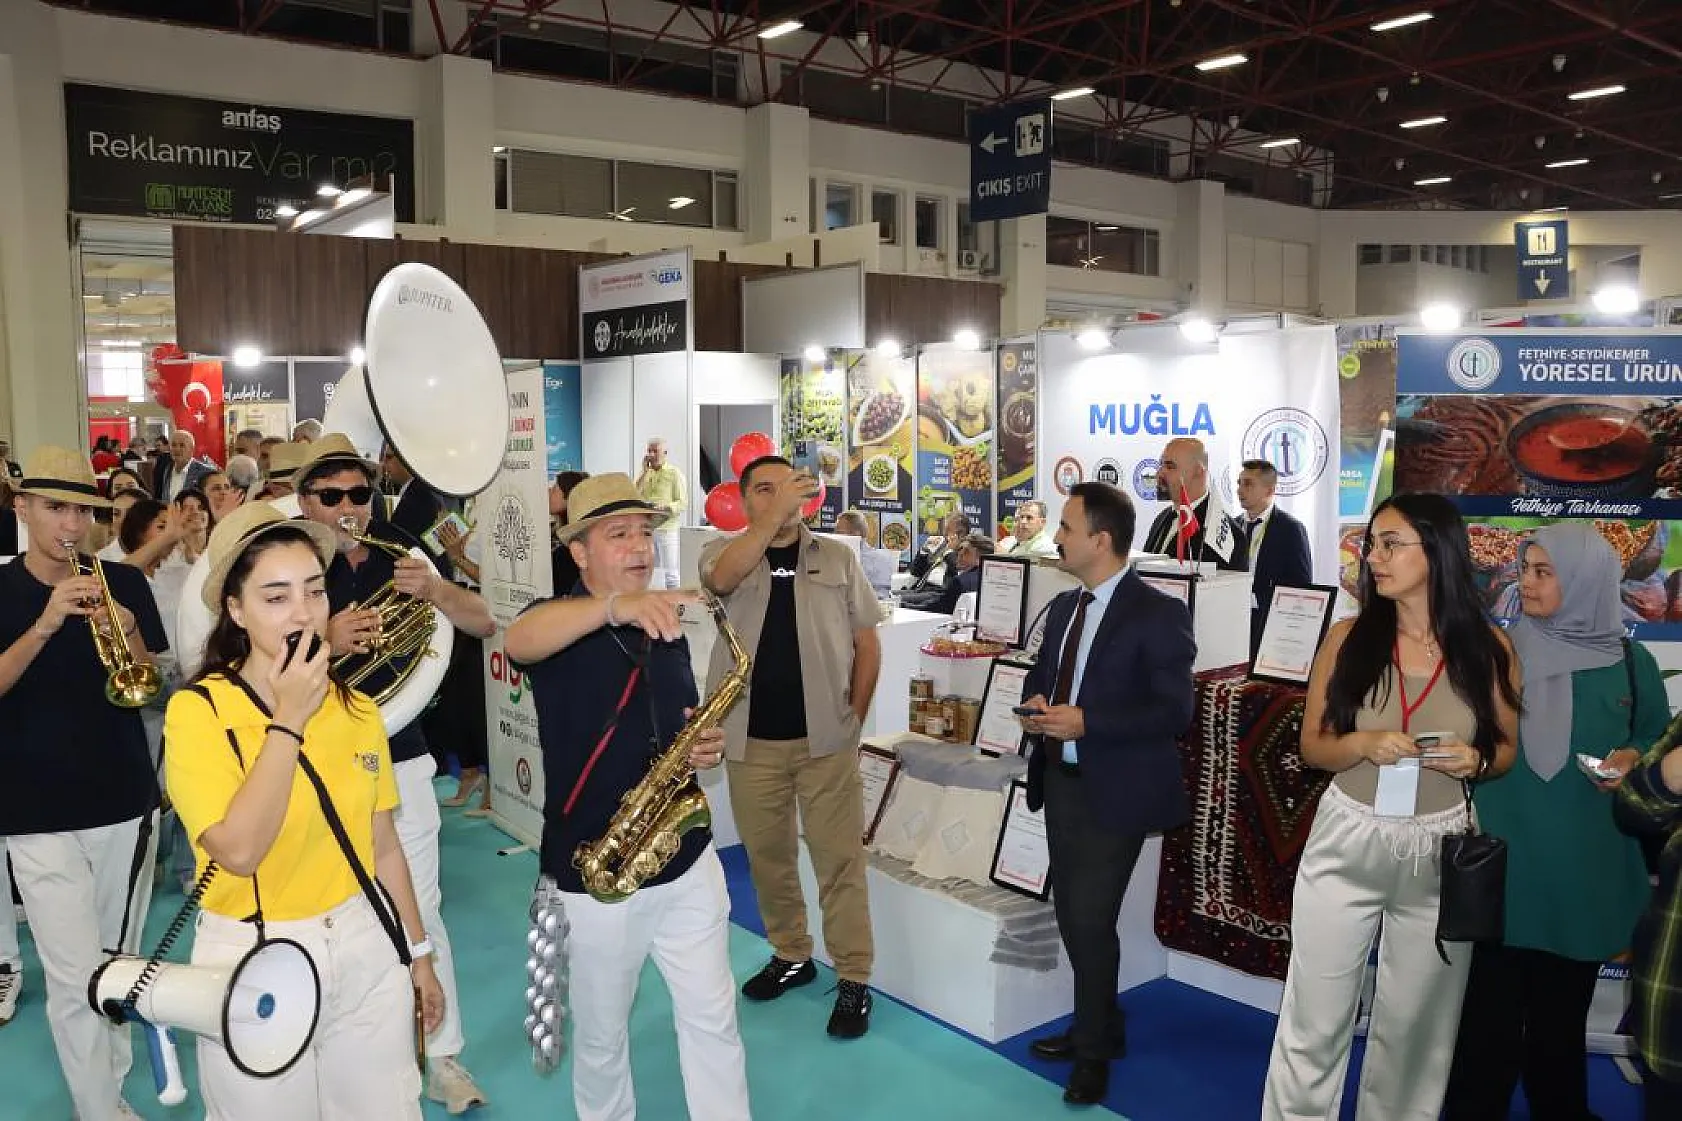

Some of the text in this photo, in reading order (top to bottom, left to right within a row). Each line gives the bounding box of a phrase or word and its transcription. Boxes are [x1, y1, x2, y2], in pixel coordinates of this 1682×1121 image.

[221, 109, 282, 133] anfaş
[88, 130, 254, 171] Reklamınız
[977, 172, 1044, 199] ÇIKIŞ EXIT
[1518, 347, 1650, 361] FETHİYE-SEYDİKEMER
[1518, 362, 1616, 383] YÖRESEL
[1089, 393, 1216, 436] MUĞLA
[1511, 498, 1642, 517] Fethiye Tarhanası
